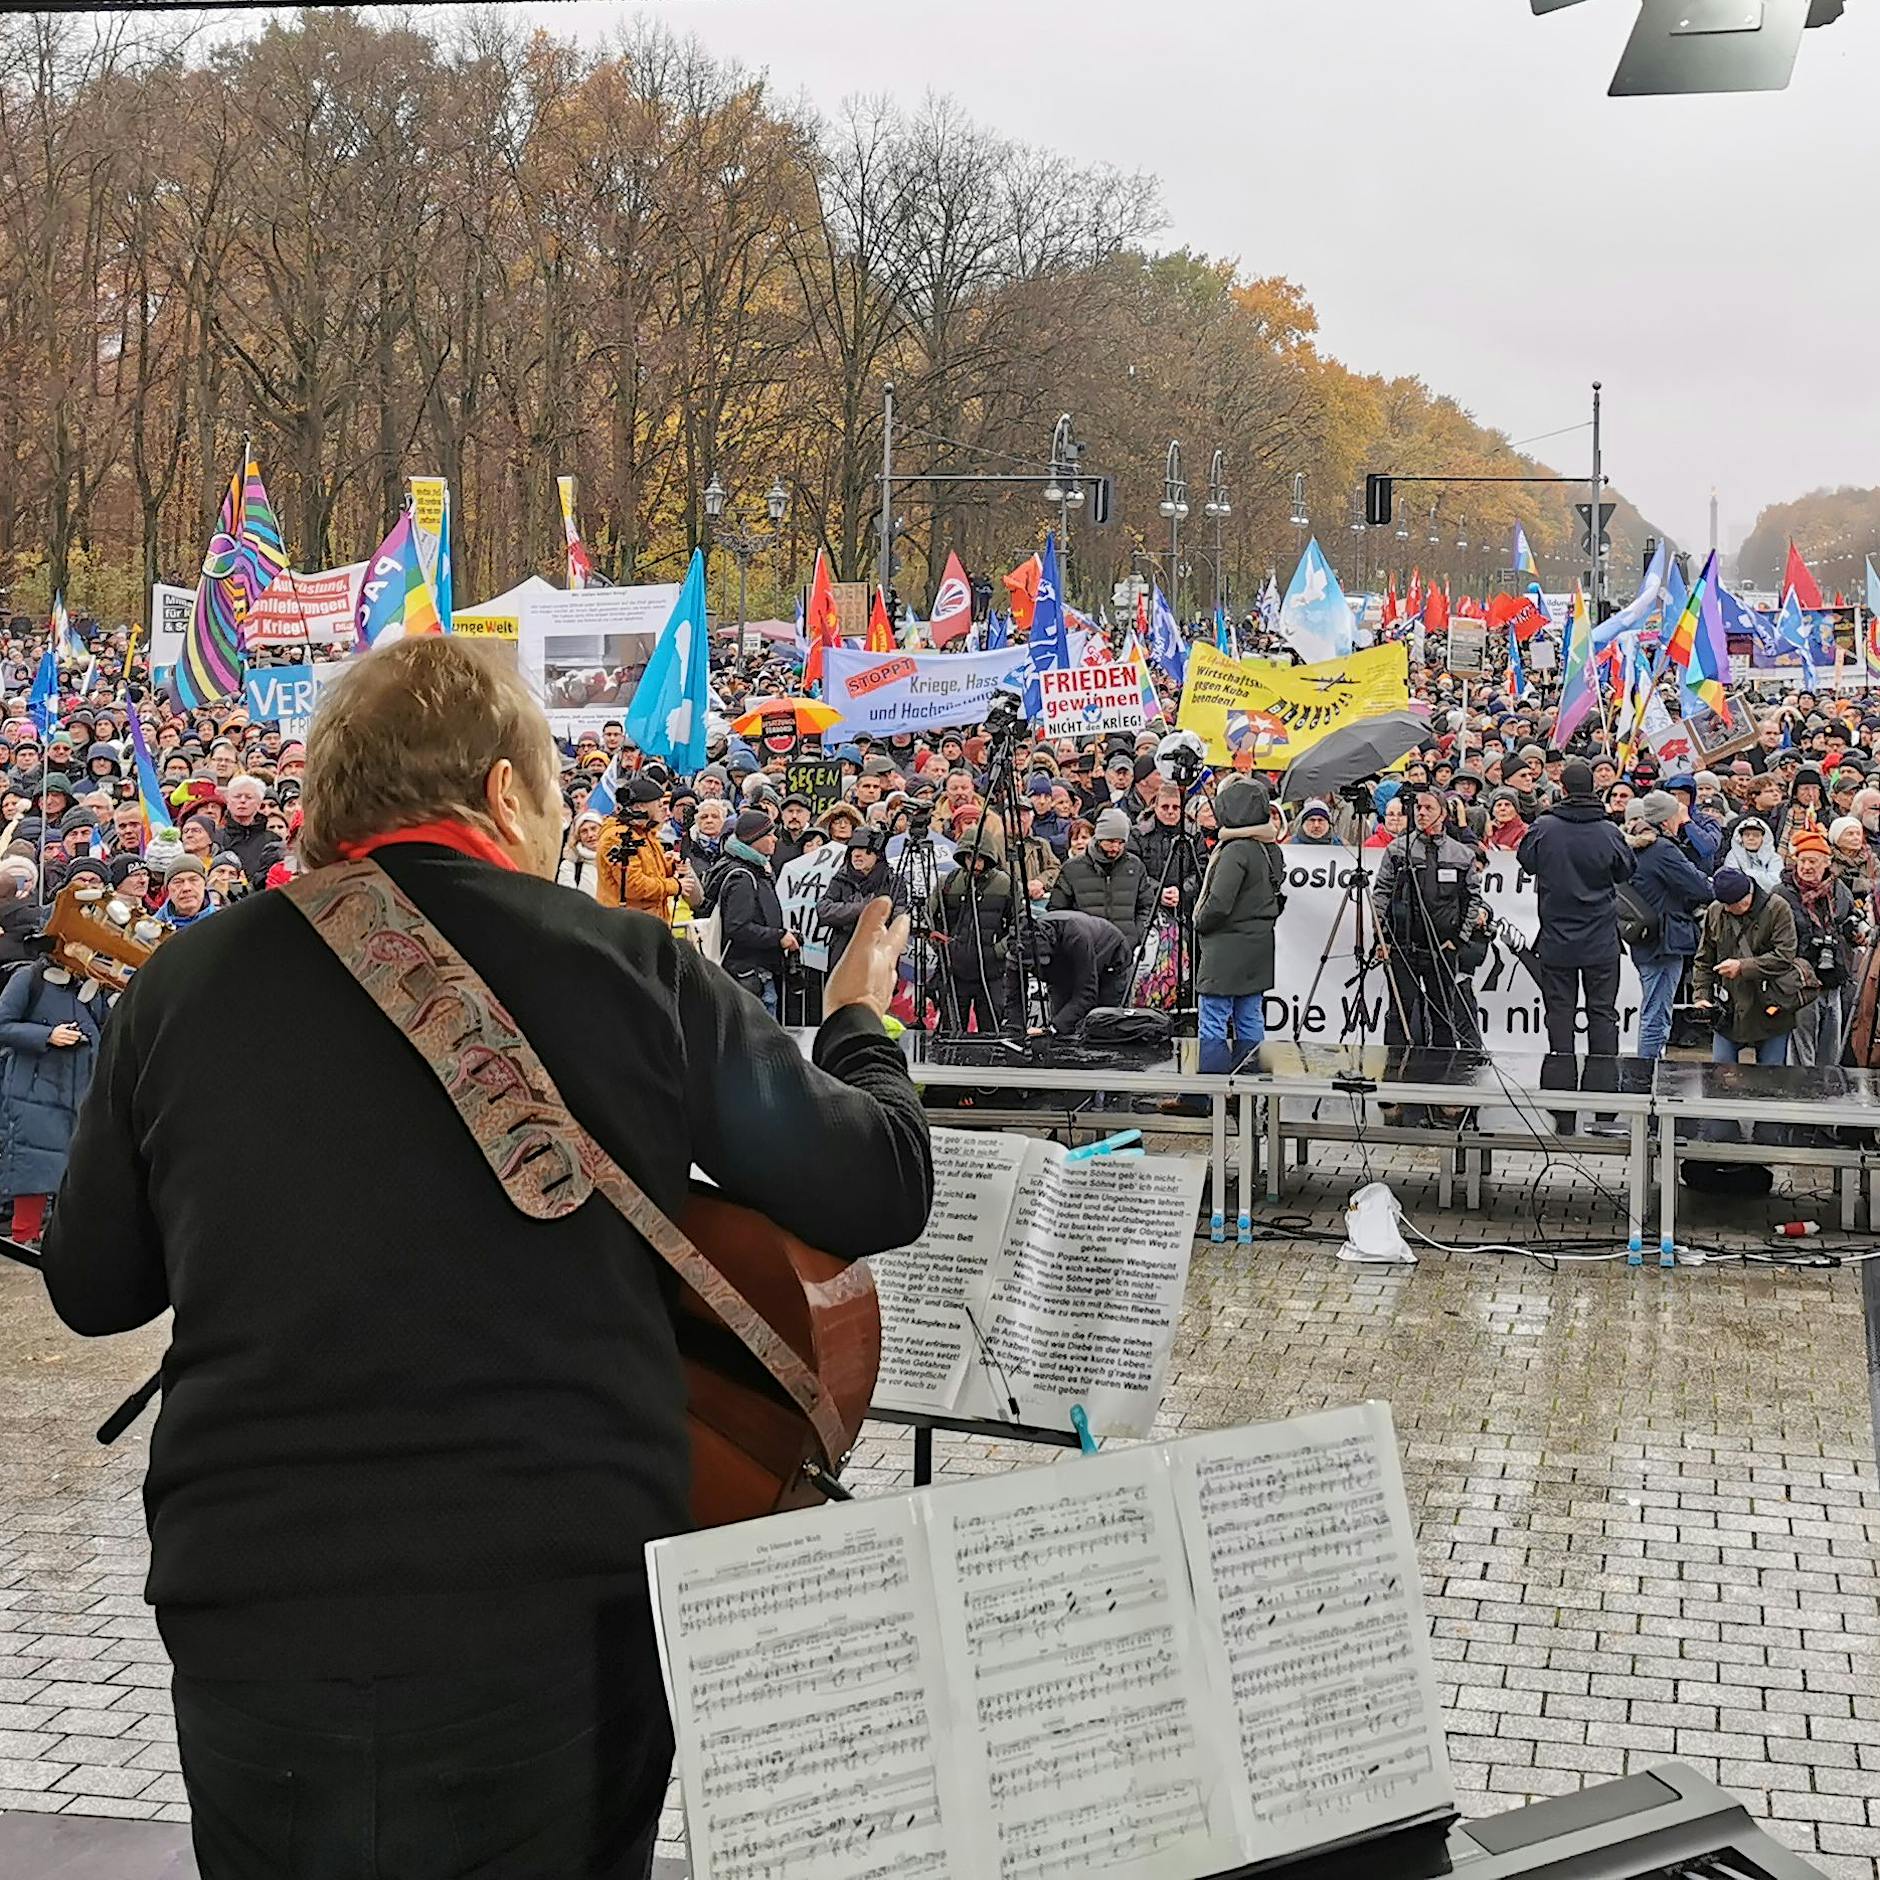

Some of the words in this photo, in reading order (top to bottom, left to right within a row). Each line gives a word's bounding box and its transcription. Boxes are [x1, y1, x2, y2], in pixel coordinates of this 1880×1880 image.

[165, 609, 181, 618] für
[251, 598, 347, 615] enlieferungen
[165, 623, 172, 631] &
[263, 619, 305, 635] Krieg!
[848, 660, 912, 693] STOPPT
[910, 675, 960, 696] Kriege,
[966, 674, 999, 691] Hass
[1044, 665, 1137, 694] FRIEDEN
[1193, 680, 1221, 691] gegen
[1223, 684, 1249, 698] Kuba
[1047, 692, 1139, 717] gewinnen
[1191, 693, 1235, 707] beenden!
[869, 703, 897, 721] und
[1049, 718, 1082, 736] NICHT
[1085, 723, 1100, 731] den
[1262, 995, 1326, 1033] Die
